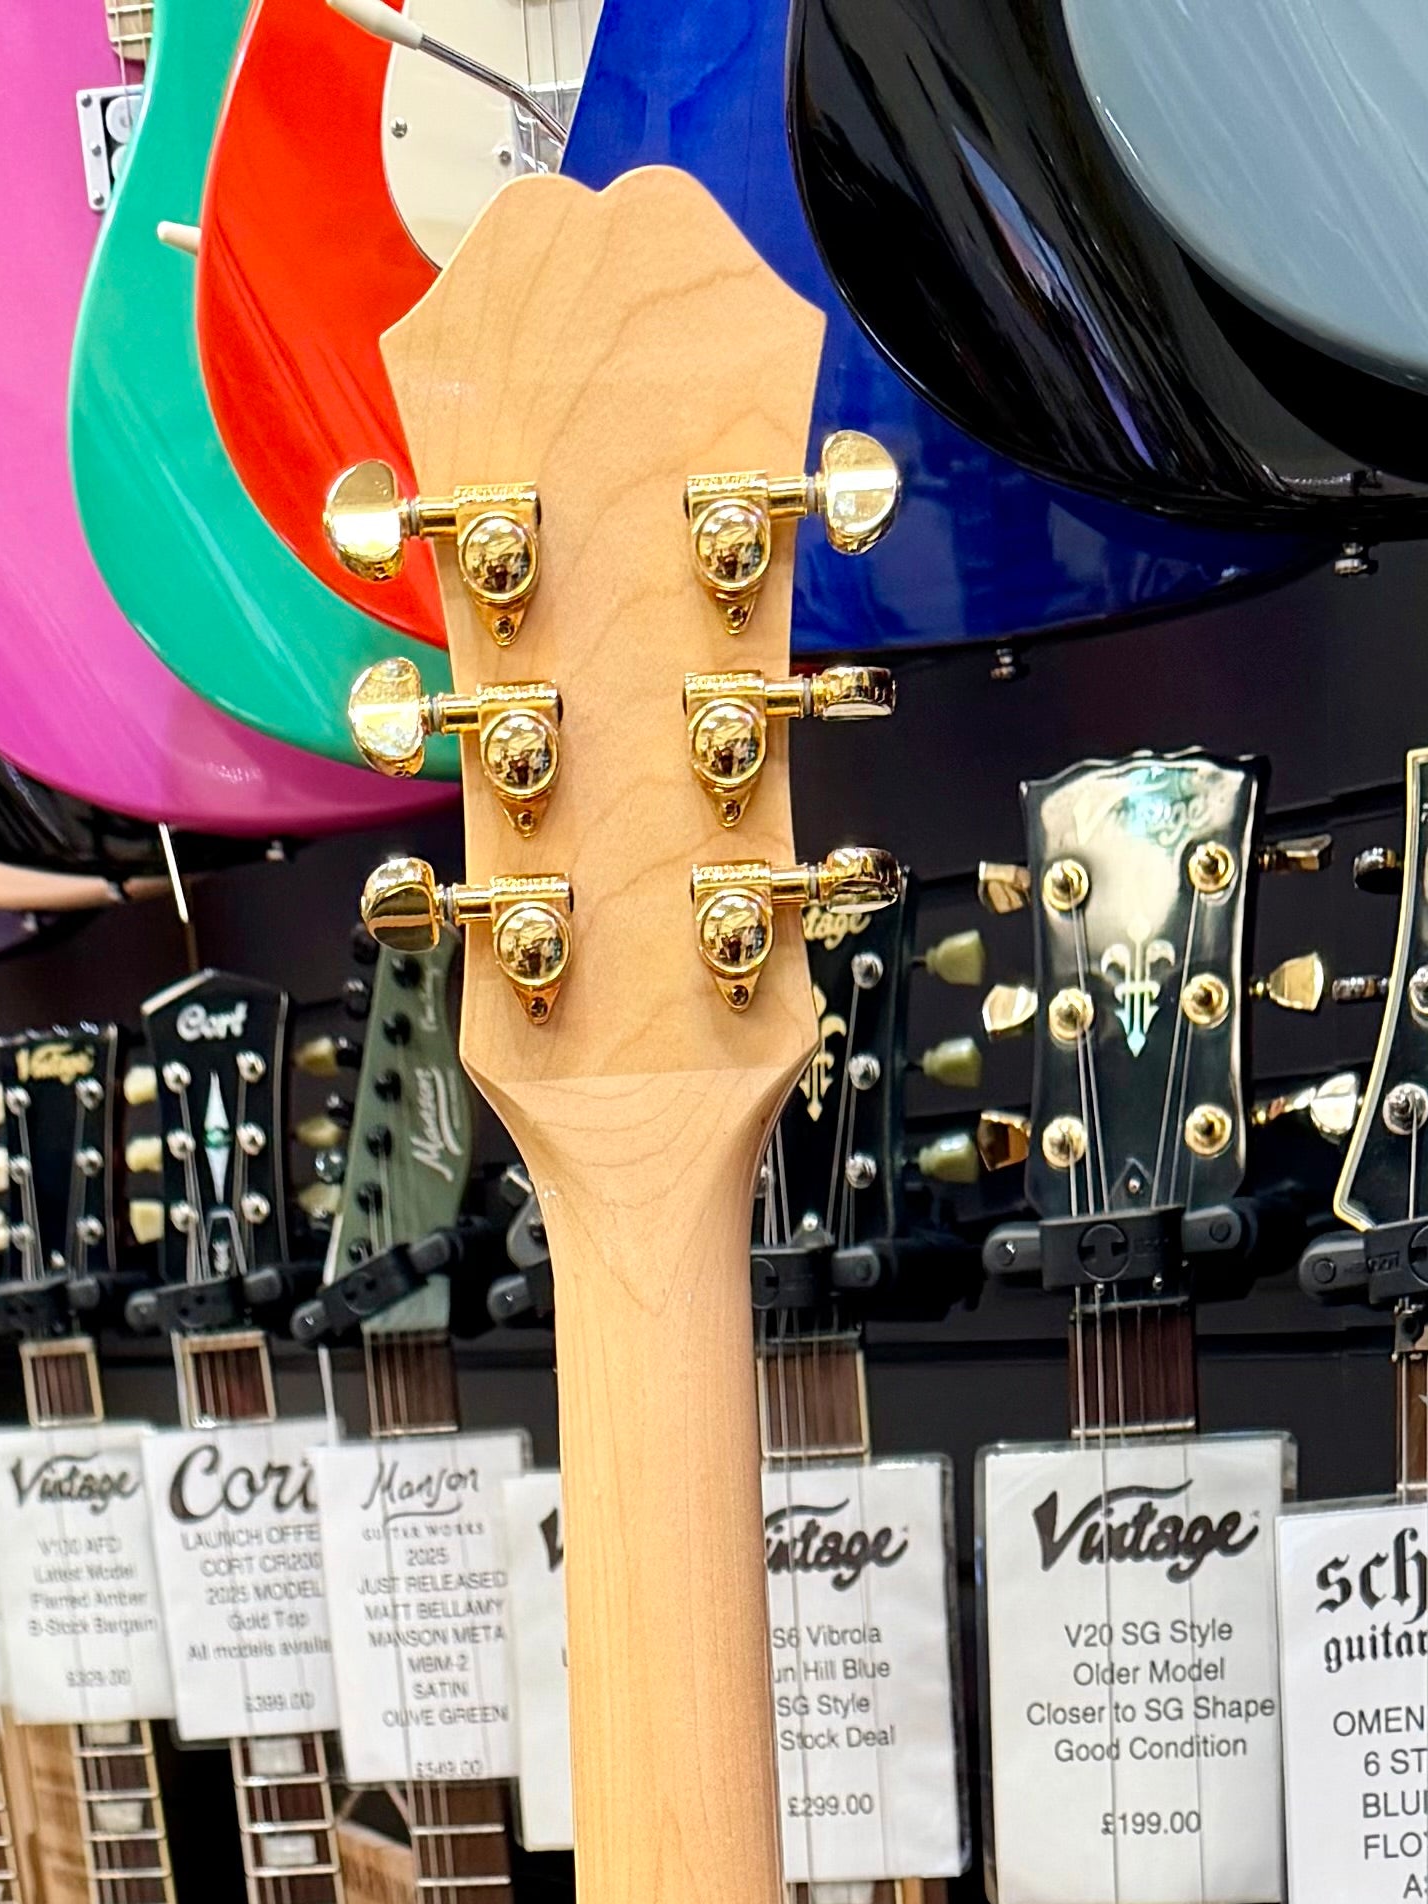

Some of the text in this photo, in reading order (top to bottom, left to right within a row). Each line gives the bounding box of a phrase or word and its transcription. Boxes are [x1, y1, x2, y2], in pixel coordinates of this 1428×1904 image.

[802, 904, 871, 950] tage
[176, 1001, 248, 1041] Cort
[10, 1451, 143, 1515] Vintage
[361, 1461, 479, 1509] Manson
[180, 1523, 321, 1551] LAUNCH OFFE
[765, 1498, 909, 1590] intage
[1032, 1479, 1259, 1584] Vintage
[253, 1580, 325, 1600] MODEL
[357, 1571, 509, 1595] JUST RELEASED
[364, 1598, 504, 1621] MATT BELLAMY
[368, 1625, 506, 1648] MANSON META
[772, 1624, 882, 1649] S6 Vibrola
[1064, 1618, 1233, 1648] V20 SG Style
[280, 1637, 332, 1656] availa
[1324, 1622, 1428, 1673] guitar
[803, 1660, 837, 1681] Hill
[843, 1658, 891, 1679] Blue
[1073, 1657, 1225, 1687] Older Model
[412, 1681, 471, 1700] SATIN
[382, 1705, 510, 1728] OLIVE GREEN
[776, 1693, 871, 1719] SG Style
[1026, 1695, 1276, 1726] Closer to SG Shape
[1333, 1705, 1425, 1737] OMEN
[780, 1724, 896, 1750] Stock Deal
[1054, 1734, 1248, 1762] Good Condition
[1364, 1751, 1380, 1776] 6
[787, 1794, 874, 1818] £299.00
[1102, 1810, 1201, 1835] £199.00
